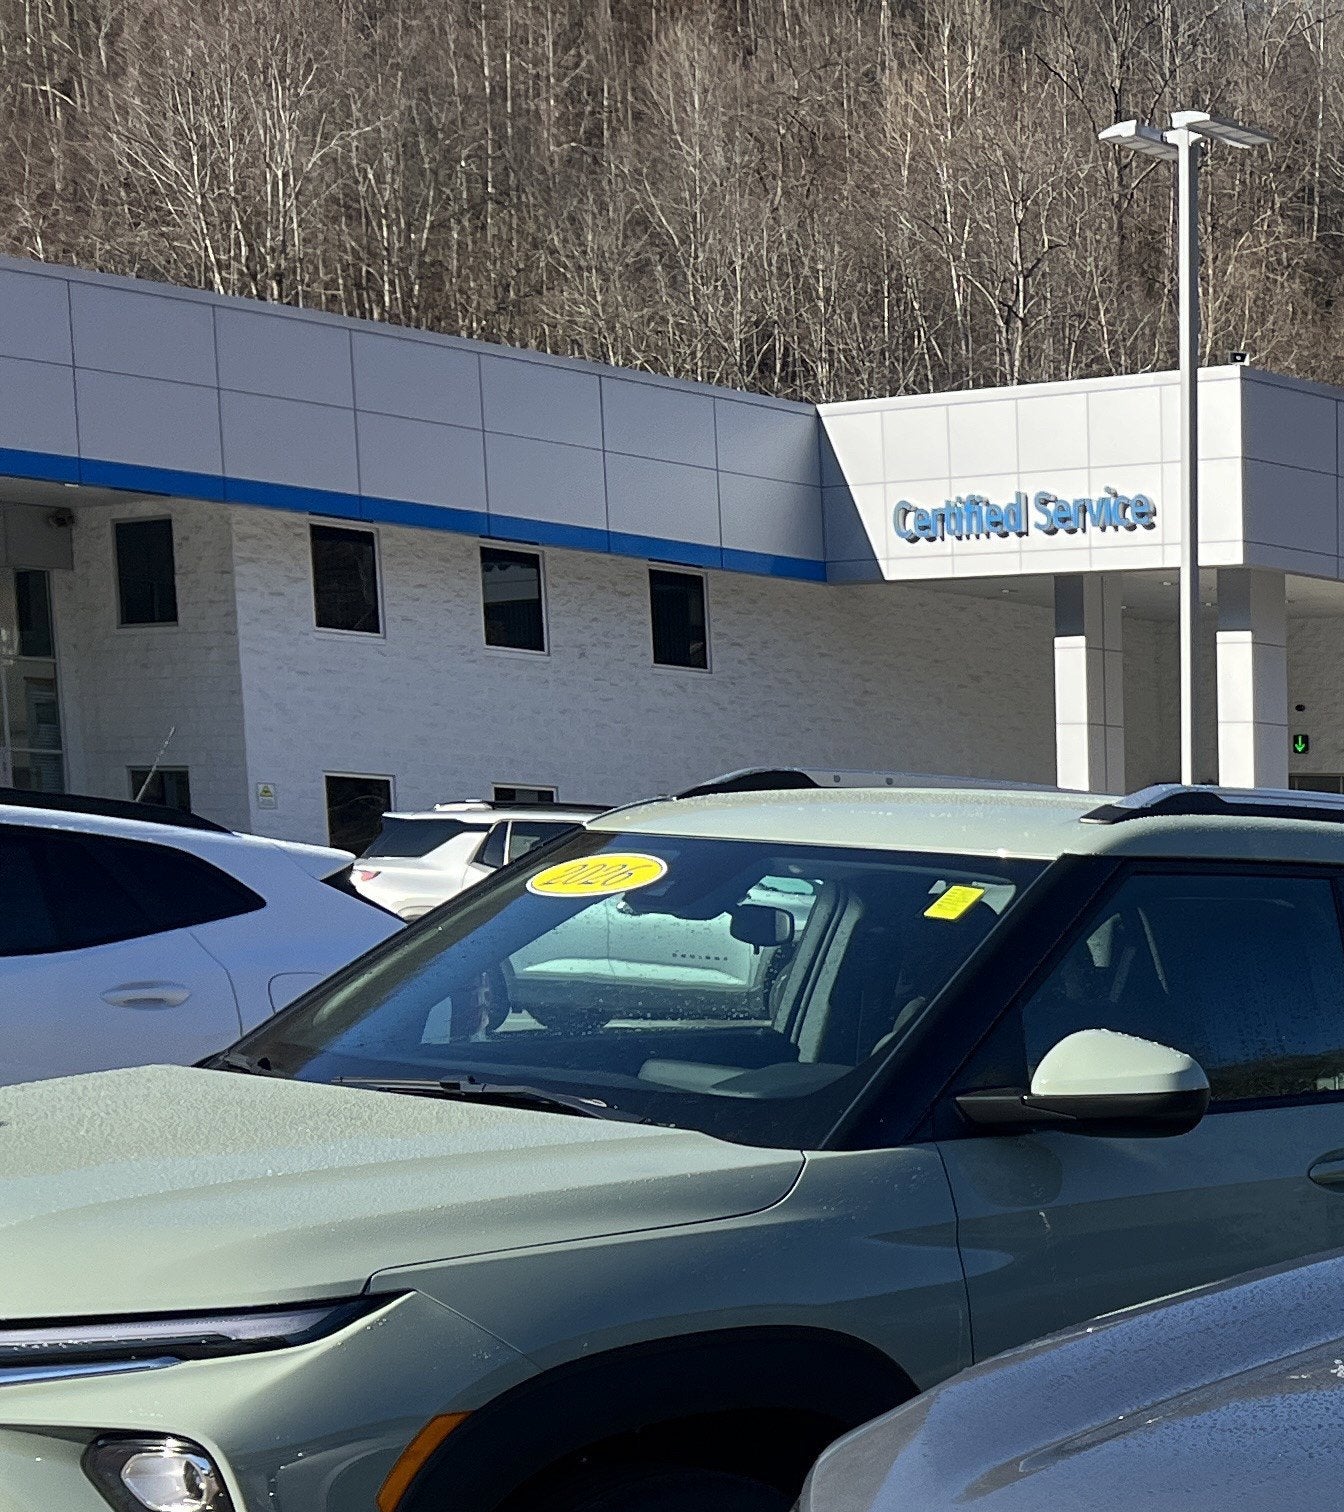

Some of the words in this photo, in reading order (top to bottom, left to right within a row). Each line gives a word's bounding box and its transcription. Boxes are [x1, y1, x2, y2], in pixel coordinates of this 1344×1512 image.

[893, 491, 1028, 543] Certified
[1034, 486, 1156, 536] Service
[538, 863, 654, 887] 2026
